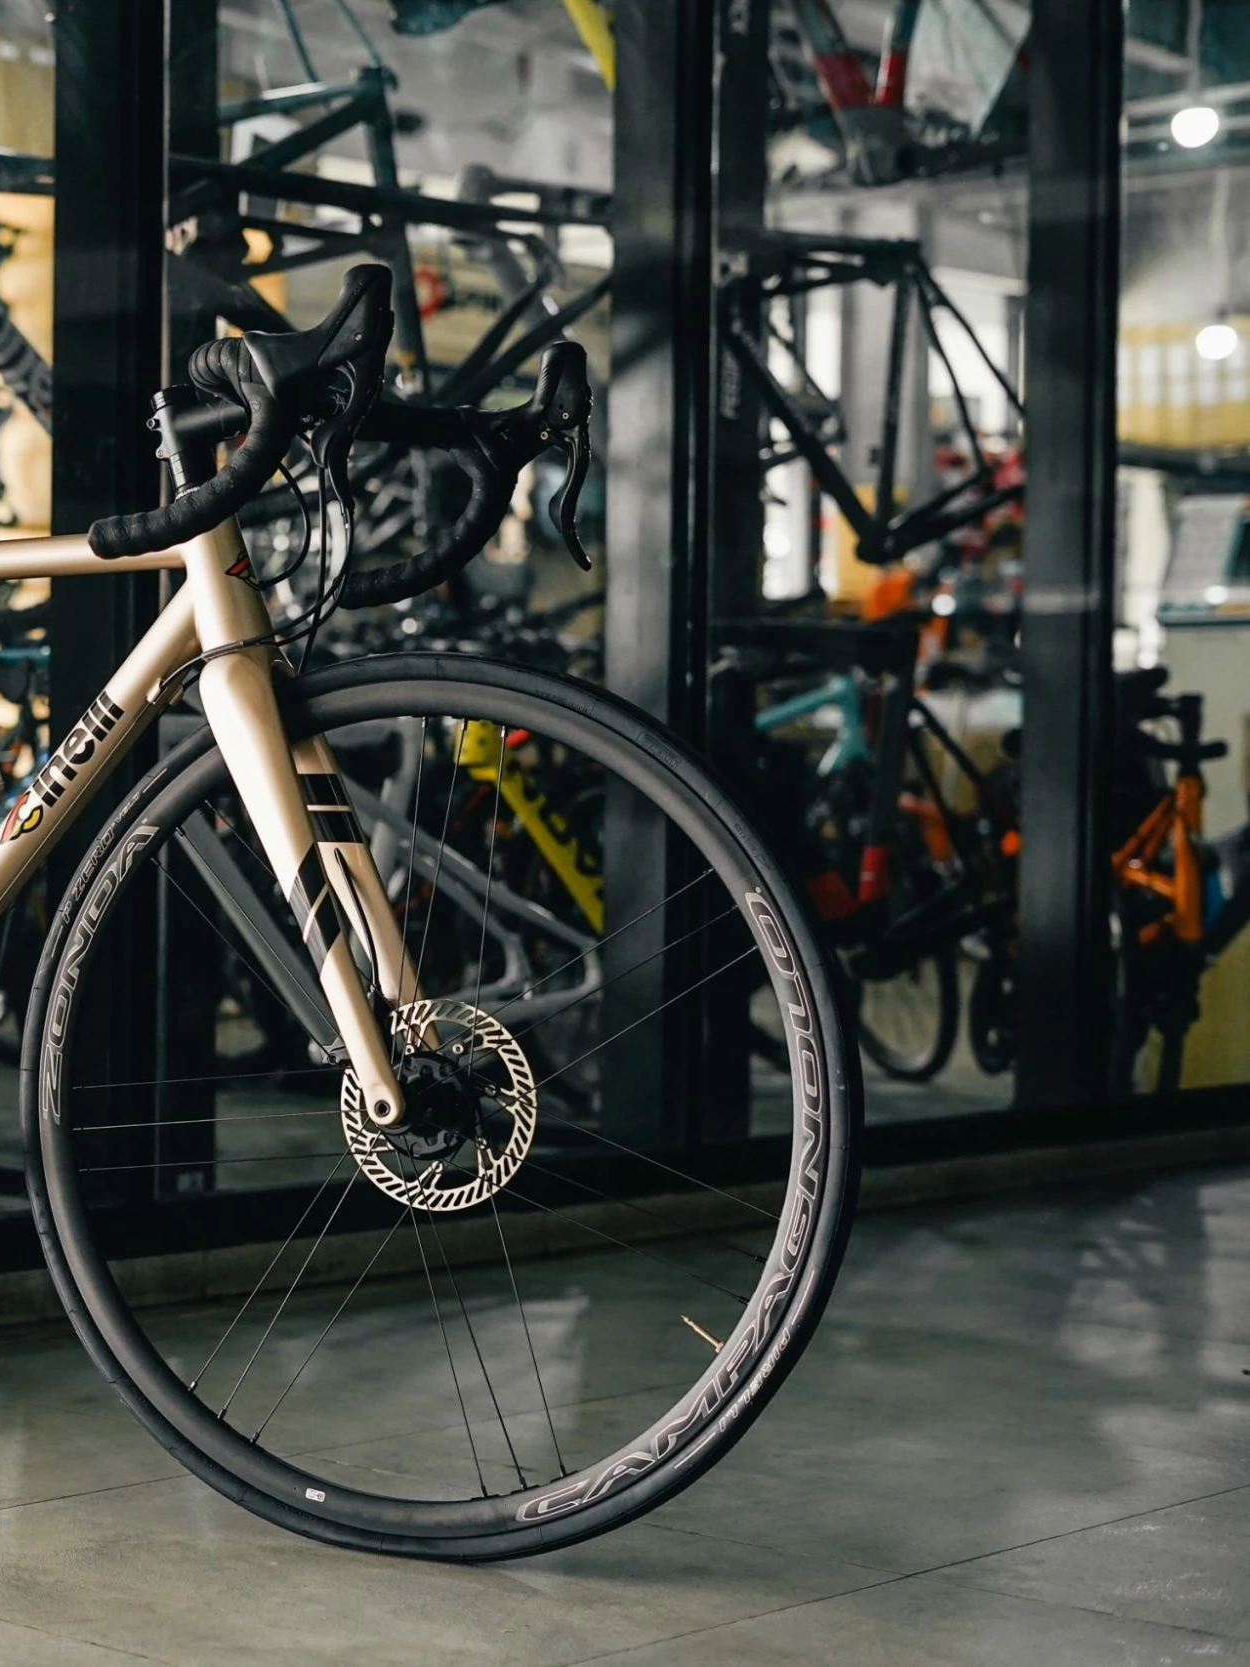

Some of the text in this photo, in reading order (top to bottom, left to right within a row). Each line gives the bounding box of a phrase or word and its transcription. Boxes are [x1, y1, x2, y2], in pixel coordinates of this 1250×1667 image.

[43, 826, 161, 1125] ZONDA
[61, 900, 73, 925] P
[72, 826, 115, 901] ZERO
[515, 891, 825, 1523] CAMPAGNOLO
